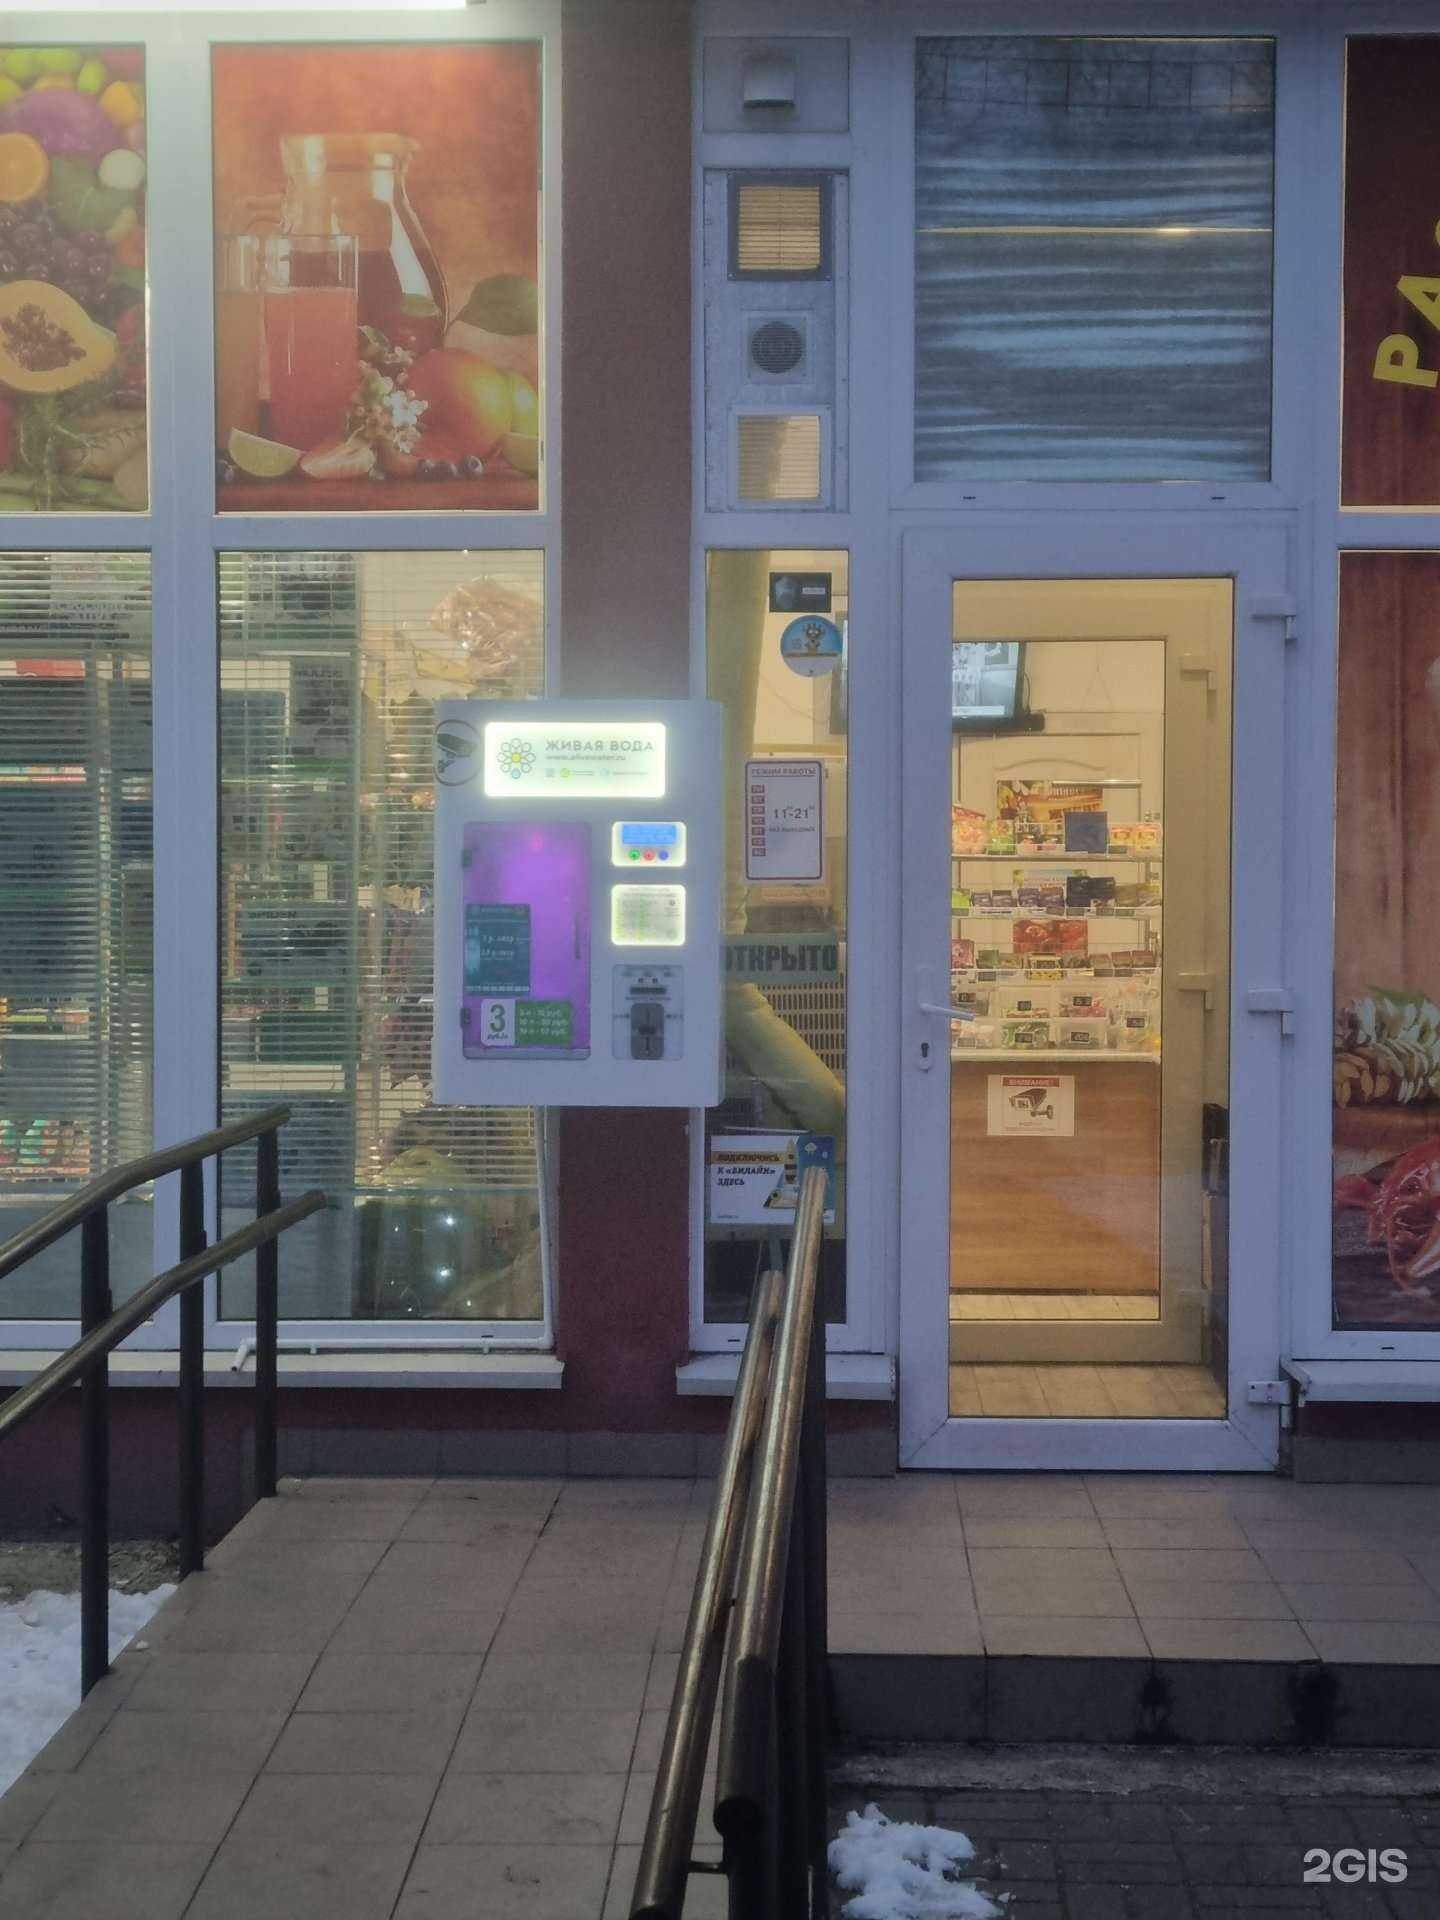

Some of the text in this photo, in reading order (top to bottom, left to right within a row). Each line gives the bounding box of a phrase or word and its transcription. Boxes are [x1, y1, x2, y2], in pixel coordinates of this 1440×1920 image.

[1373, 219, 1440, 388] РА
[546, 740, 653, 752] ЖИВАЯ ВОДА
[490, 1004, 506, 1032] 3
